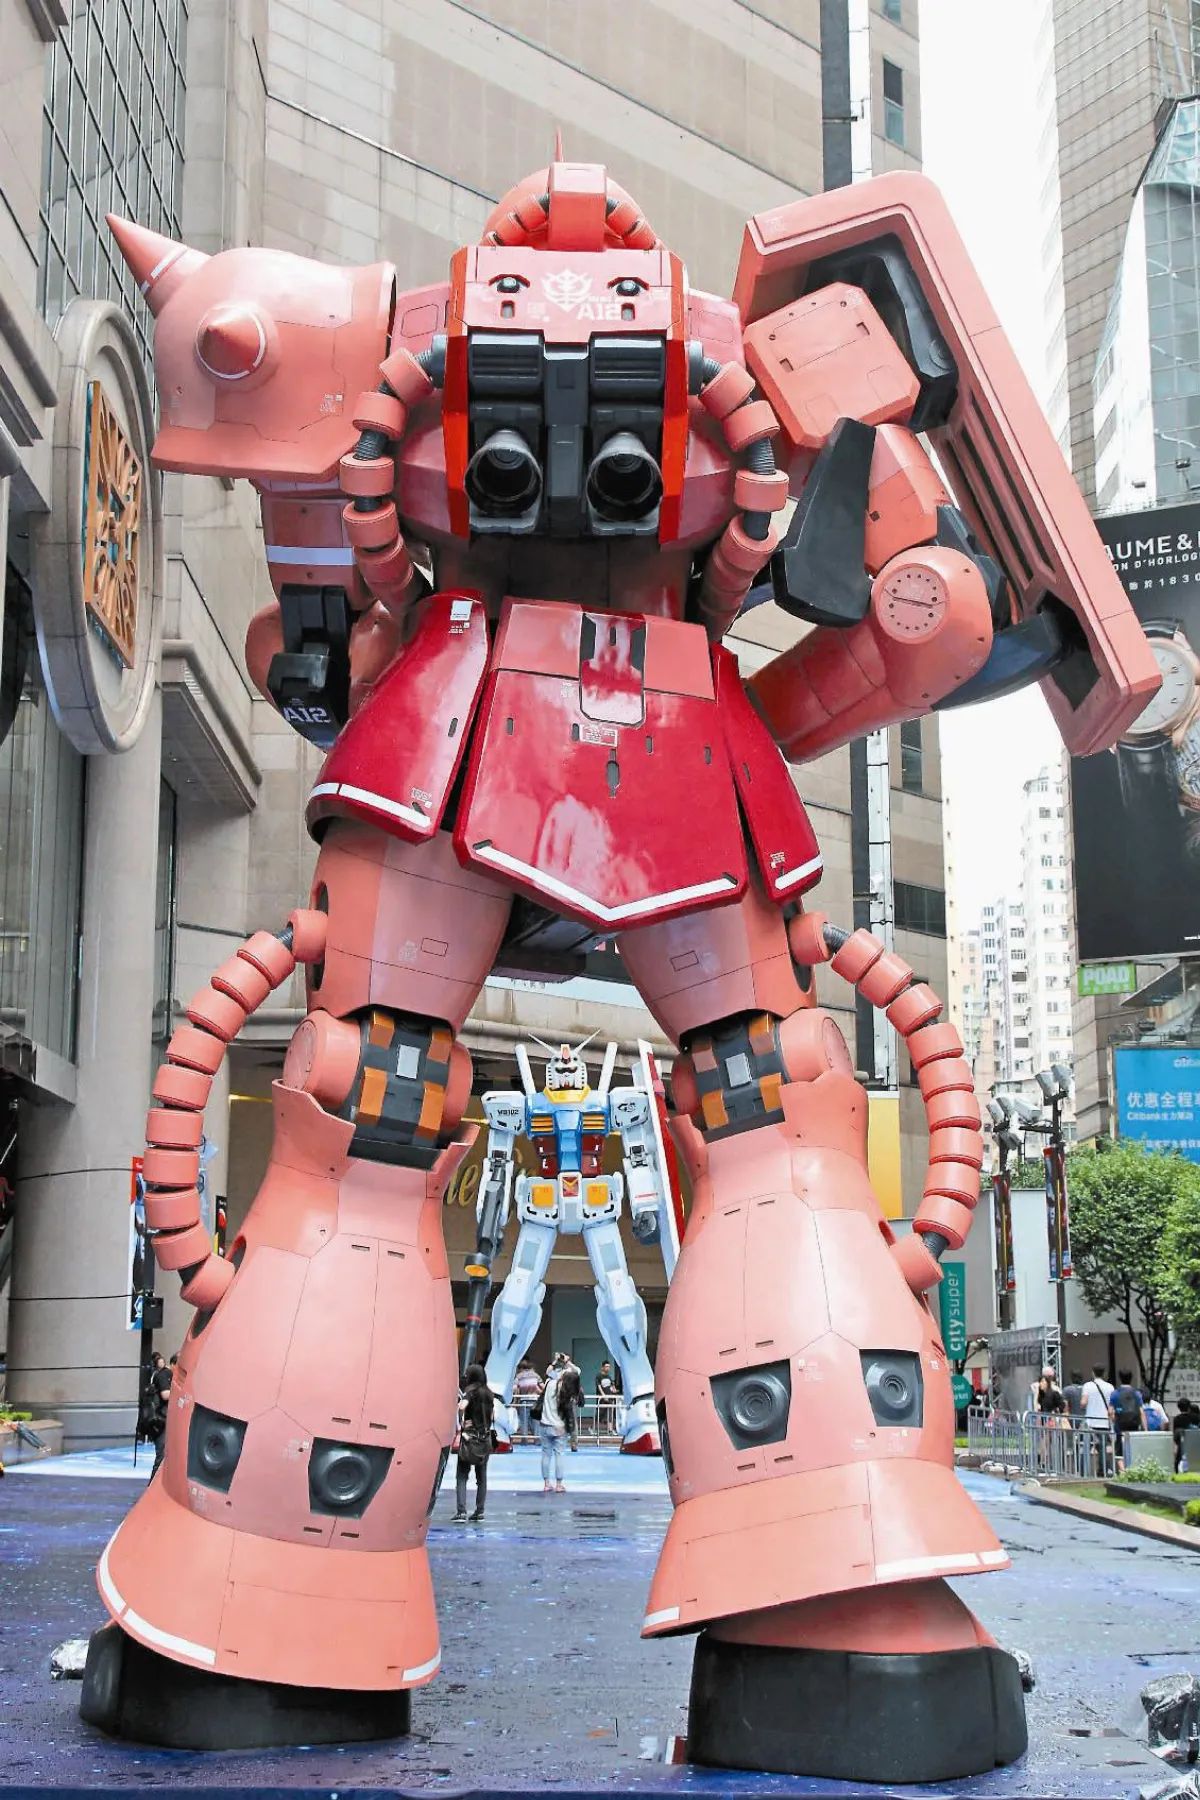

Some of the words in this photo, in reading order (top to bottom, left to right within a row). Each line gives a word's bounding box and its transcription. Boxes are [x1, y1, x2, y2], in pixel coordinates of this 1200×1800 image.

[576, 303, 622, 321] A12
[1176, 533, 1193, 551] &
[1134, 552, 1200, 569] D'HORLOG
[283, 706, 331, 723] A12
[1083, 965, 1130, 986] POAD
